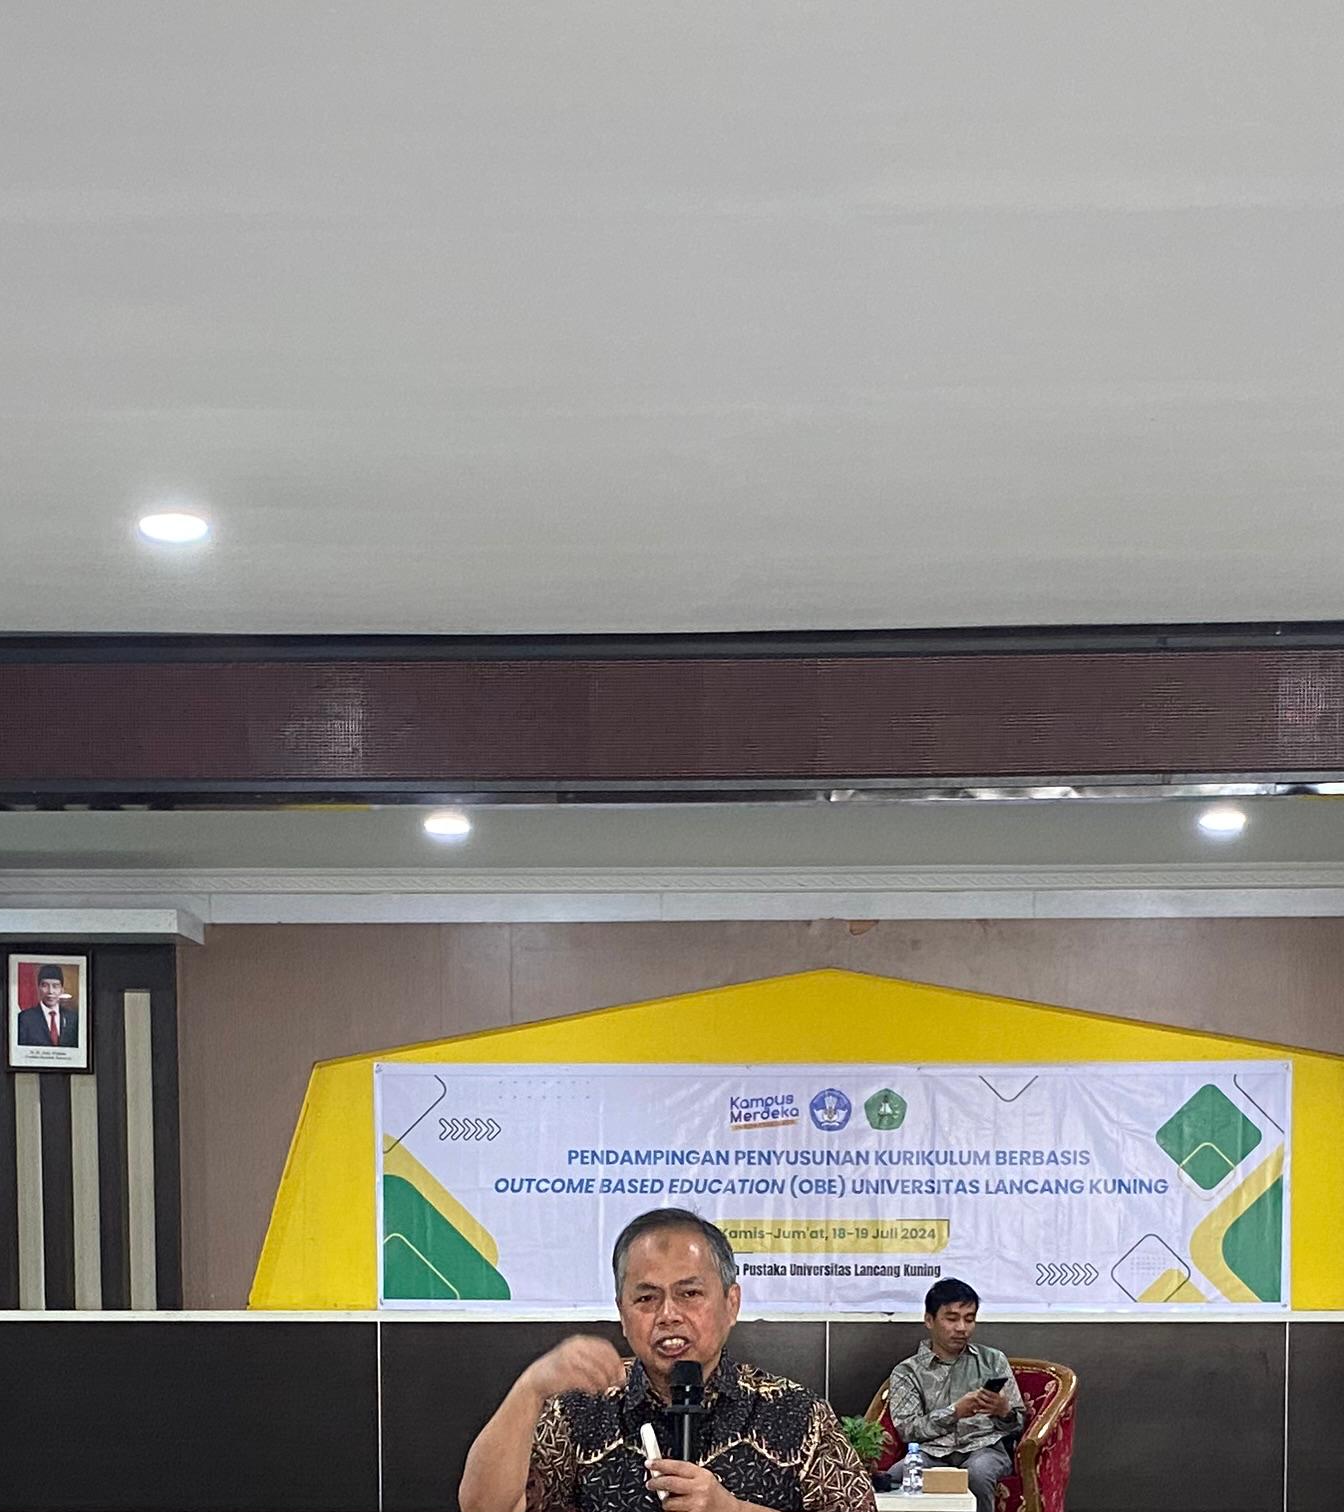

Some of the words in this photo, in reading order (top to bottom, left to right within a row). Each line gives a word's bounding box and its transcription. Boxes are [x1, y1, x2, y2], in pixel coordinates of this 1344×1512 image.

[730, 1094, 794, 1111] Kampus
[729, 1106, 800, 1124] Merdeka
[567, 1149, 729, 1166] PENDAMPINGAN
[734, 1149, 870, 1166] PENYUSUNAN
[874, 1149, 991, 1166] KURIKULUM
[995, 1149, 1091, 1166] BERBASIS
[494, 1177, 594, 1194] OUTCOME
[598, 1177, 664, 1194] BASED
[668, 1178, 785, 1194] EDUCATION
[789, 1174, 846, 1199] (OBE)
[851, 1178, 980, 1195] UNIVERSITAS
[984, 1178, 1084, 1195] LANCANG
[1089, 1178, 1169, 1195] KUNING
[832, 1227, 869, 1239] 18-19
[872, 1227, 898, 1240] Juli
[901, 1227, 936, 1240] 2024
[743, 1263, 787, 1276] Pustaka
[789, 1263, 852, 1277] Universitas
[855, 1263, 900, 1278] Lancang
[903, 1263, 941, 1278] Kuning
